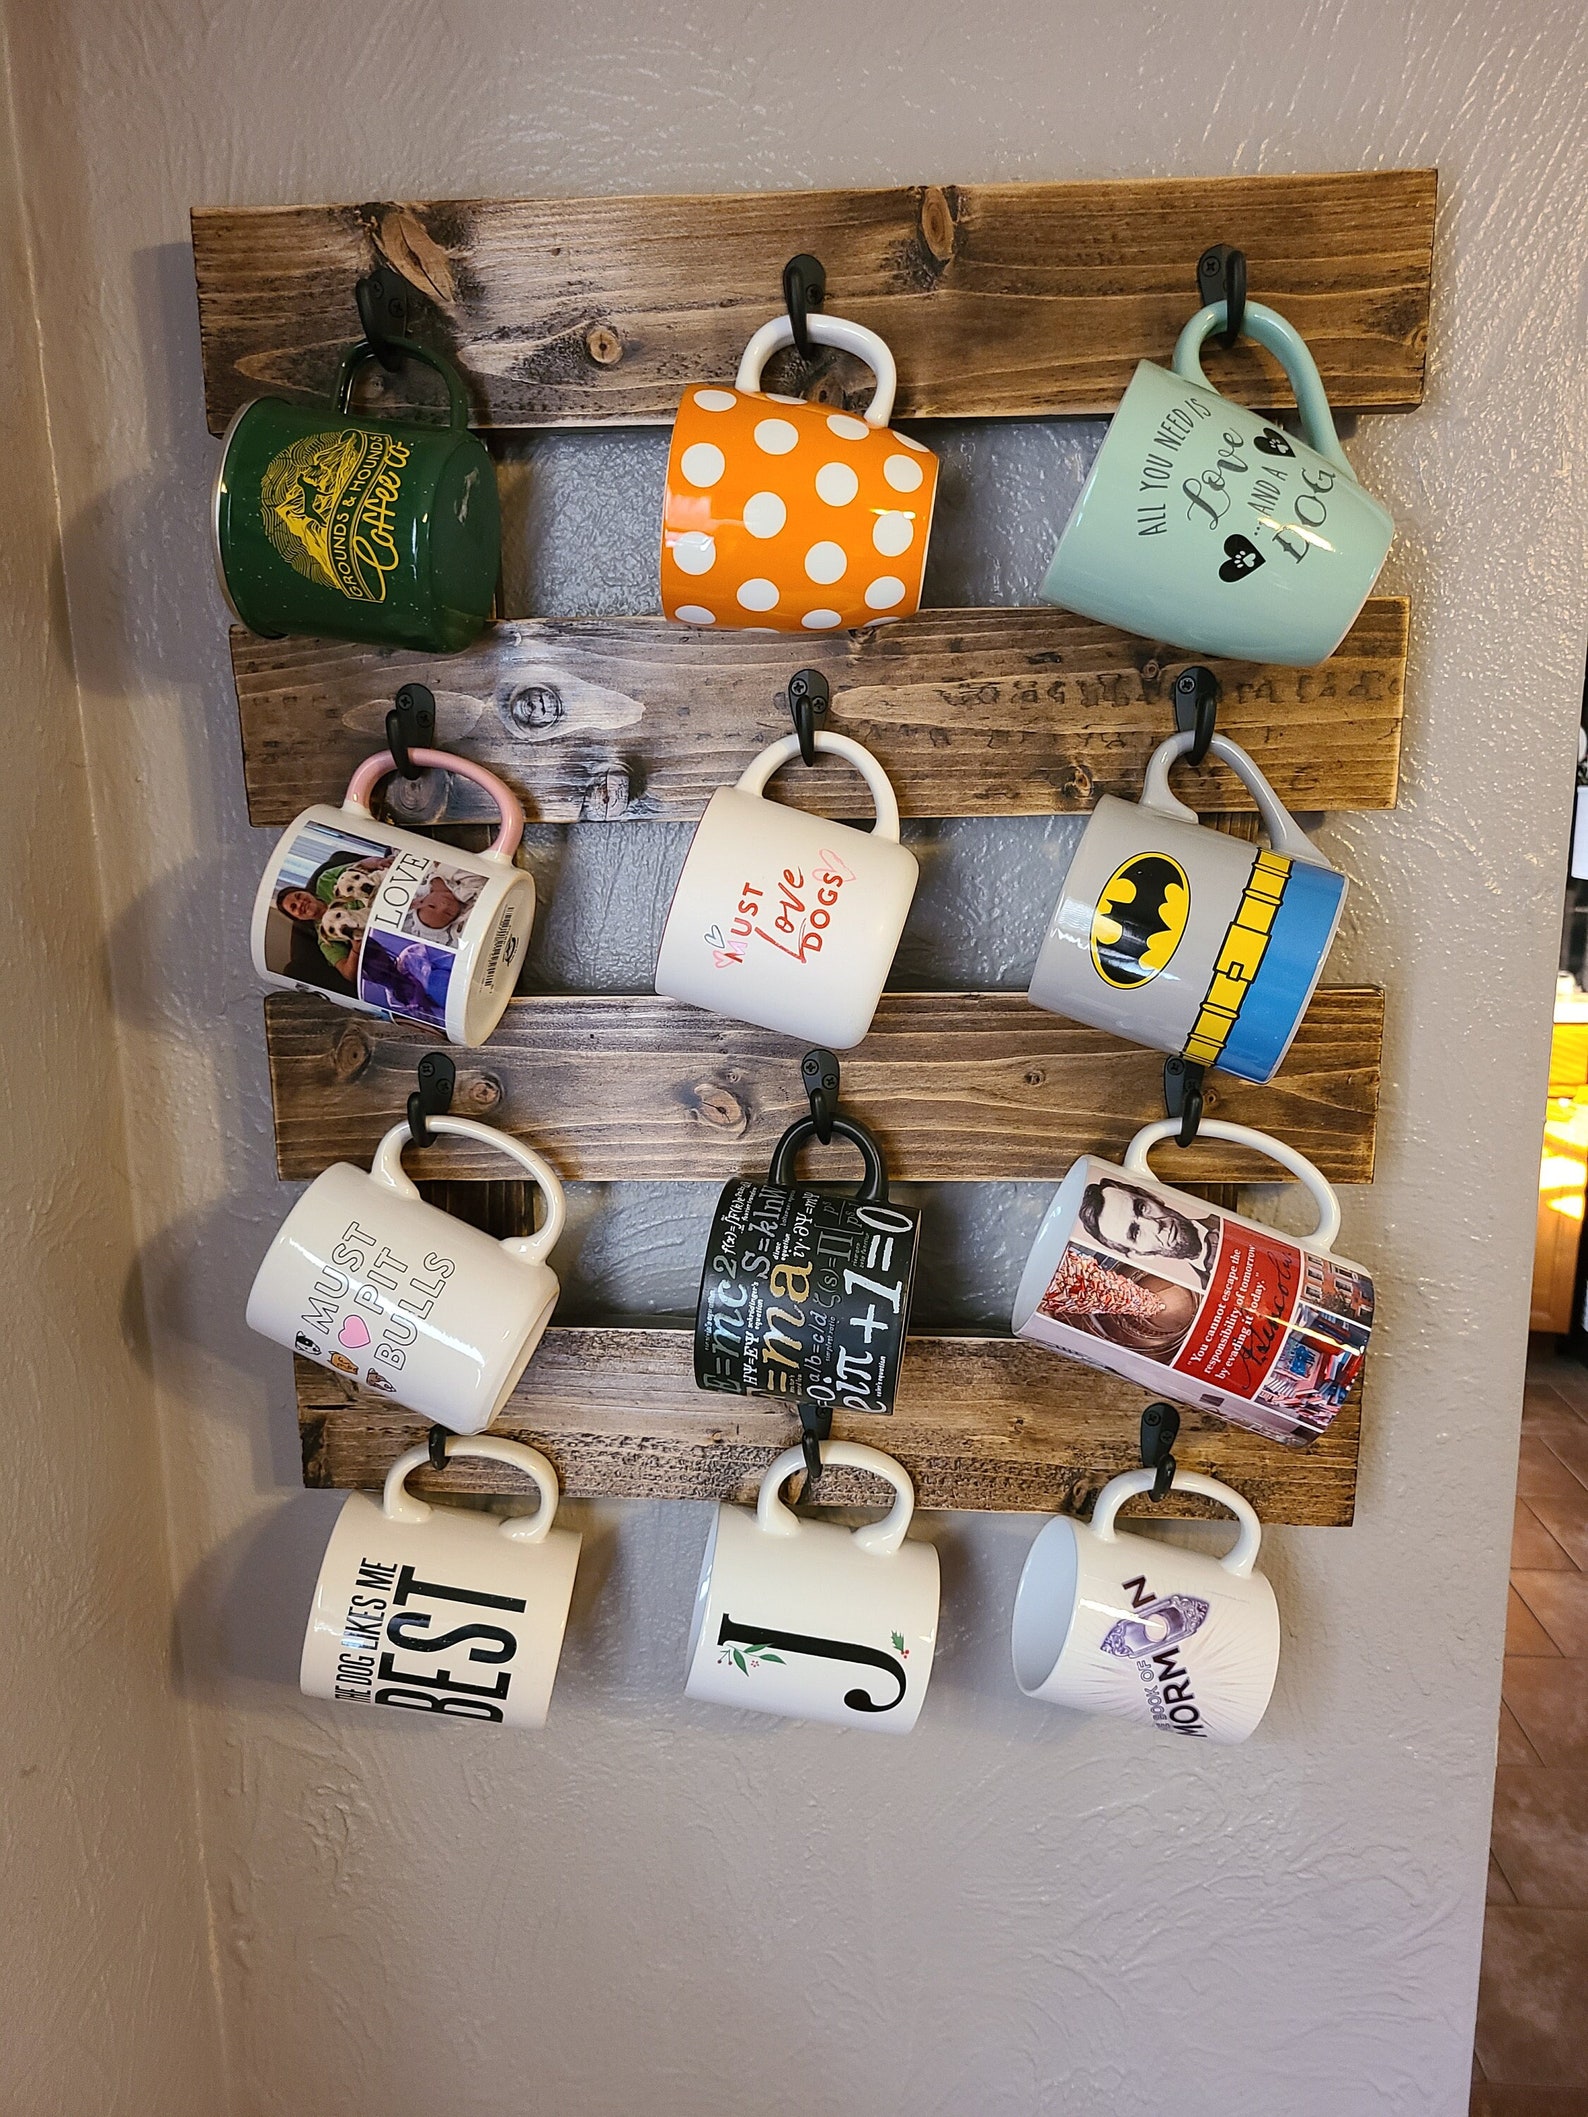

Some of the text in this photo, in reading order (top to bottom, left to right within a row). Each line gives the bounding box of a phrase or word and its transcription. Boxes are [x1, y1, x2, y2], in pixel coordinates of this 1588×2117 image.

[1137, 398, 1212, 536] ALL YOU NEED IS
[1182, 427, 1249, 530] Love
[1261, 466, 1288, 481] A
[332, 436, 383, 598] GROUNDS & HOUNDS
[1271, 467, 1337, 564] DOG
[374, 853, 430, 928] LOVE
[724, 882, 764, 963] MUST
[802, 872, 844, 952] DOGS
[301, 1220, 377, 1336] MUST
[353, 1247, 409, 1315] PIT
[373, 1252, 456, 1371] BULLS
[1203, 1245, 1257, 1374] responsibility of tomorrow
[1205, 1303, 1226, 1342] cannot
[1221, 1265, 1238, 1302] escape
[1230, 1248, 1241, 1265] the
[1214, 1367, 1230, 1380] by
[1225, 1327, 1252, 1367] evading
[1242, 1314, 1254, 1326] it
[355, 1557, 399, 1591] ME
[341, 1595, 388, 1651] LIKES
[375, 1564, 528, 1723] BEST
[717, 1612, 907, 1712] J
[336, 1653, 376, 1686] DOG
[1136, 1659, 1156, 1683] OF
